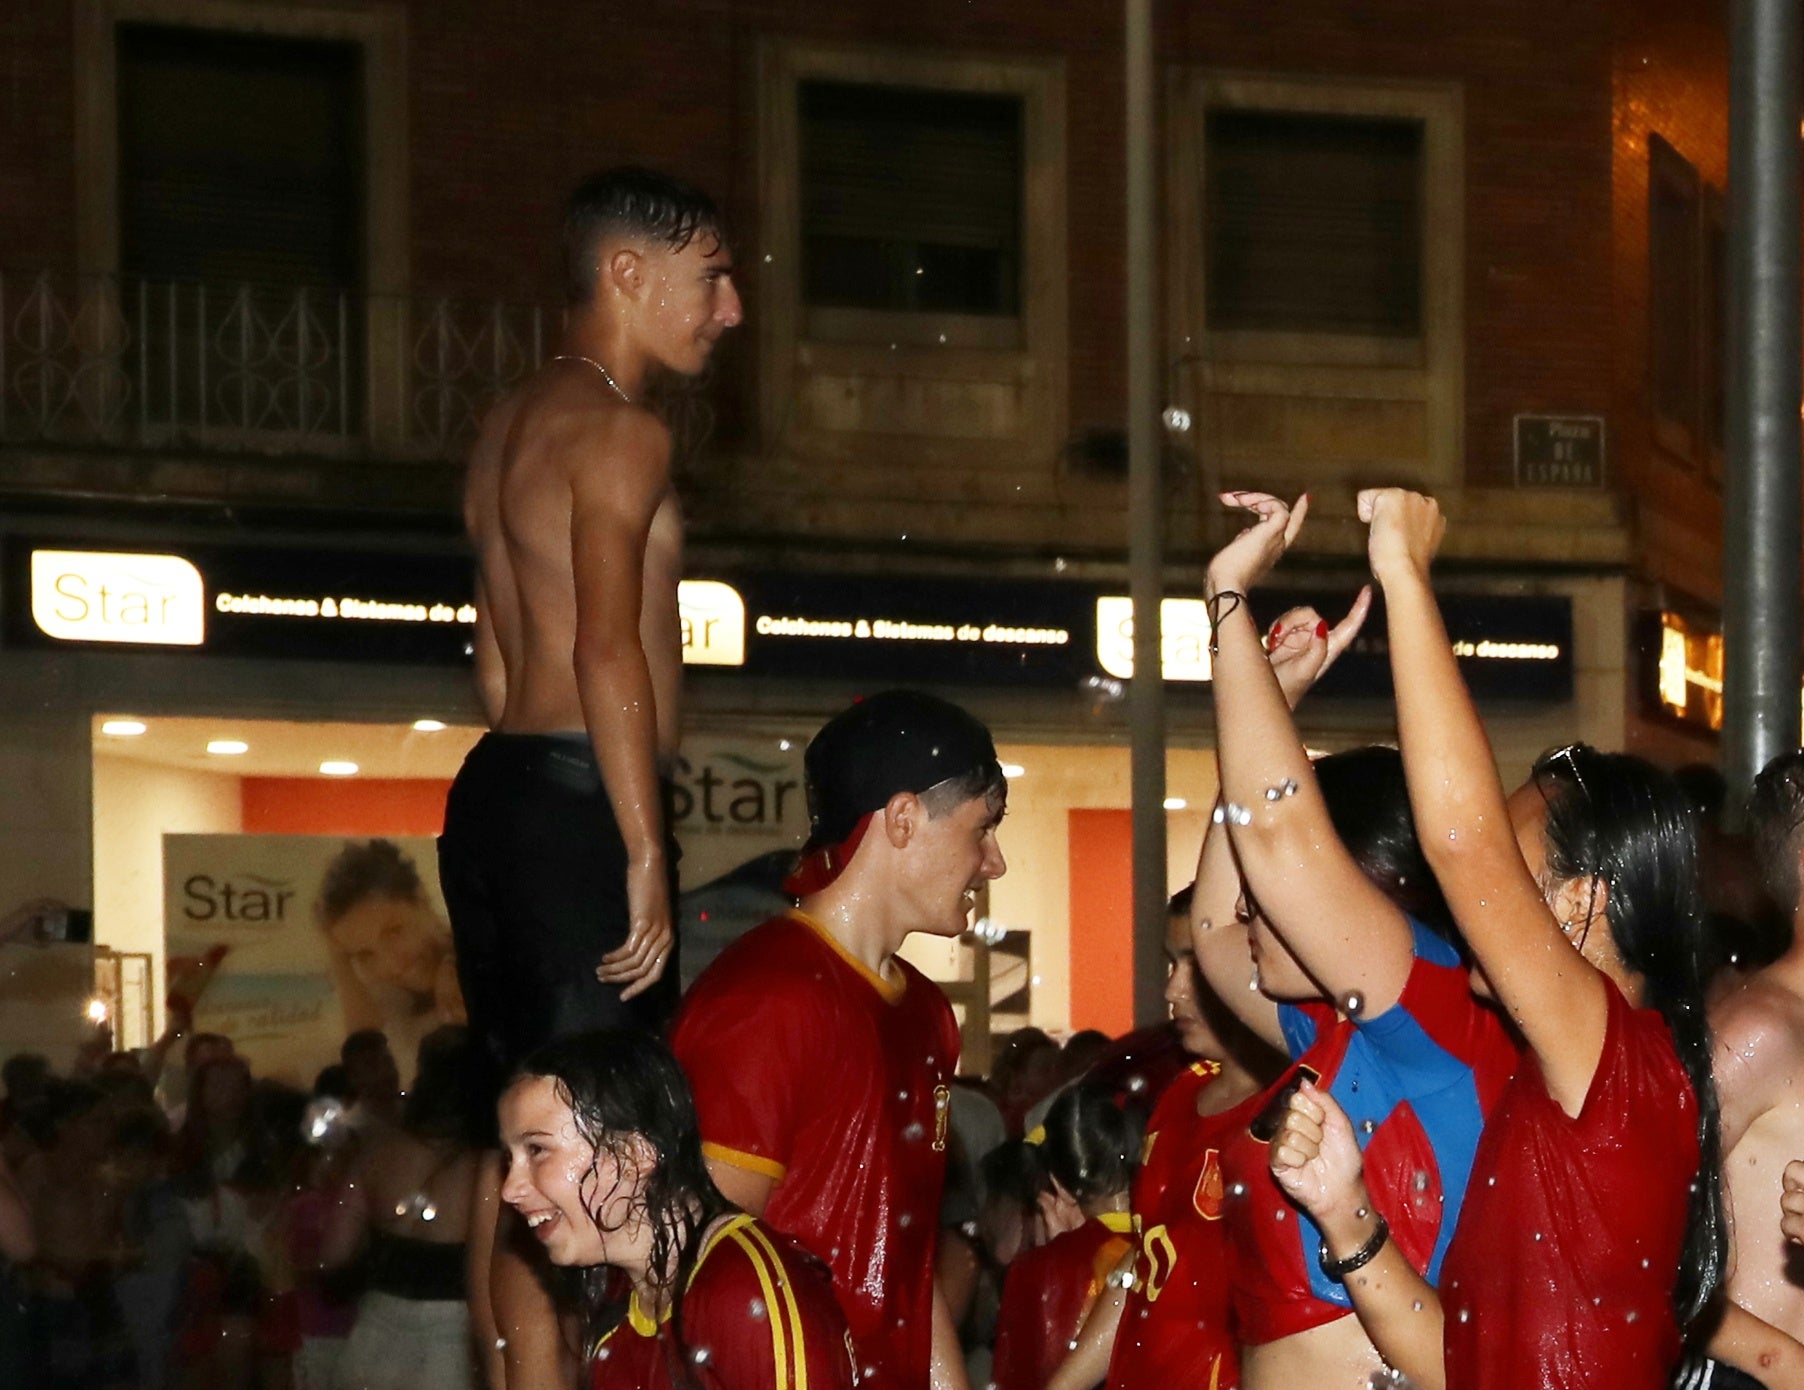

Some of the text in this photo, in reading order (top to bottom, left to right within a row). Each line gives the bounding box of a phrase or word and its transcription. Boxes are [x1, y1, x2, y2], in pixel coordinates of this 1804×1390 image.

[1526, 462, 1593, 482] ESPAÑA
[54, 572, 177, 625] Star
[429, 603, 455, 622] de
[680, 617, 720, 649] ar
[756, 615, 1069, 644] Colchones & Sistemas de descanso
[1476, 640, 1559, 660] descanso
[183, 874, 294, 922] Star
